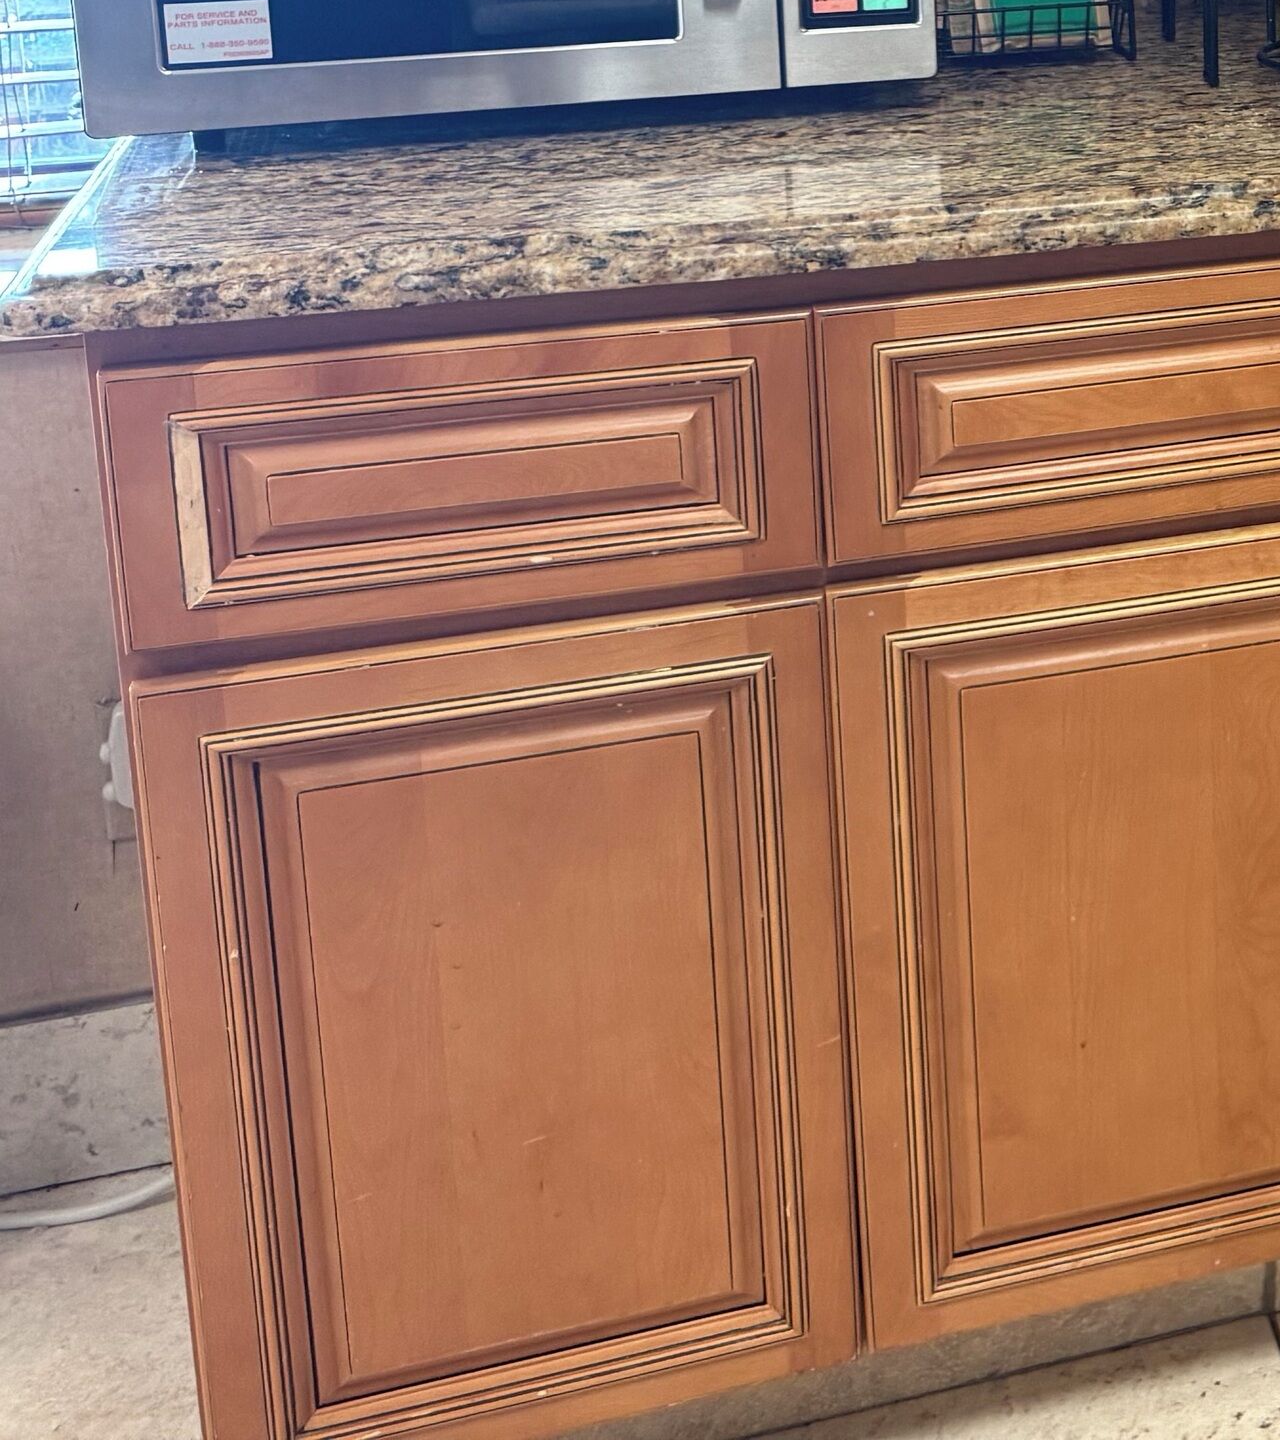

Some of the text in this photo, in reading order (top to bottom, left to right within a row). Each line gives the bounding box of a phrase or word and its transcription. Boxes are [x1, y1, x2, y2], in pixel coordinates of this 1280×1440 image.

[175, 9, 258, 21] FOR SERVICE AND
[167, 17, 267, 29] PARTS INFORMATION
